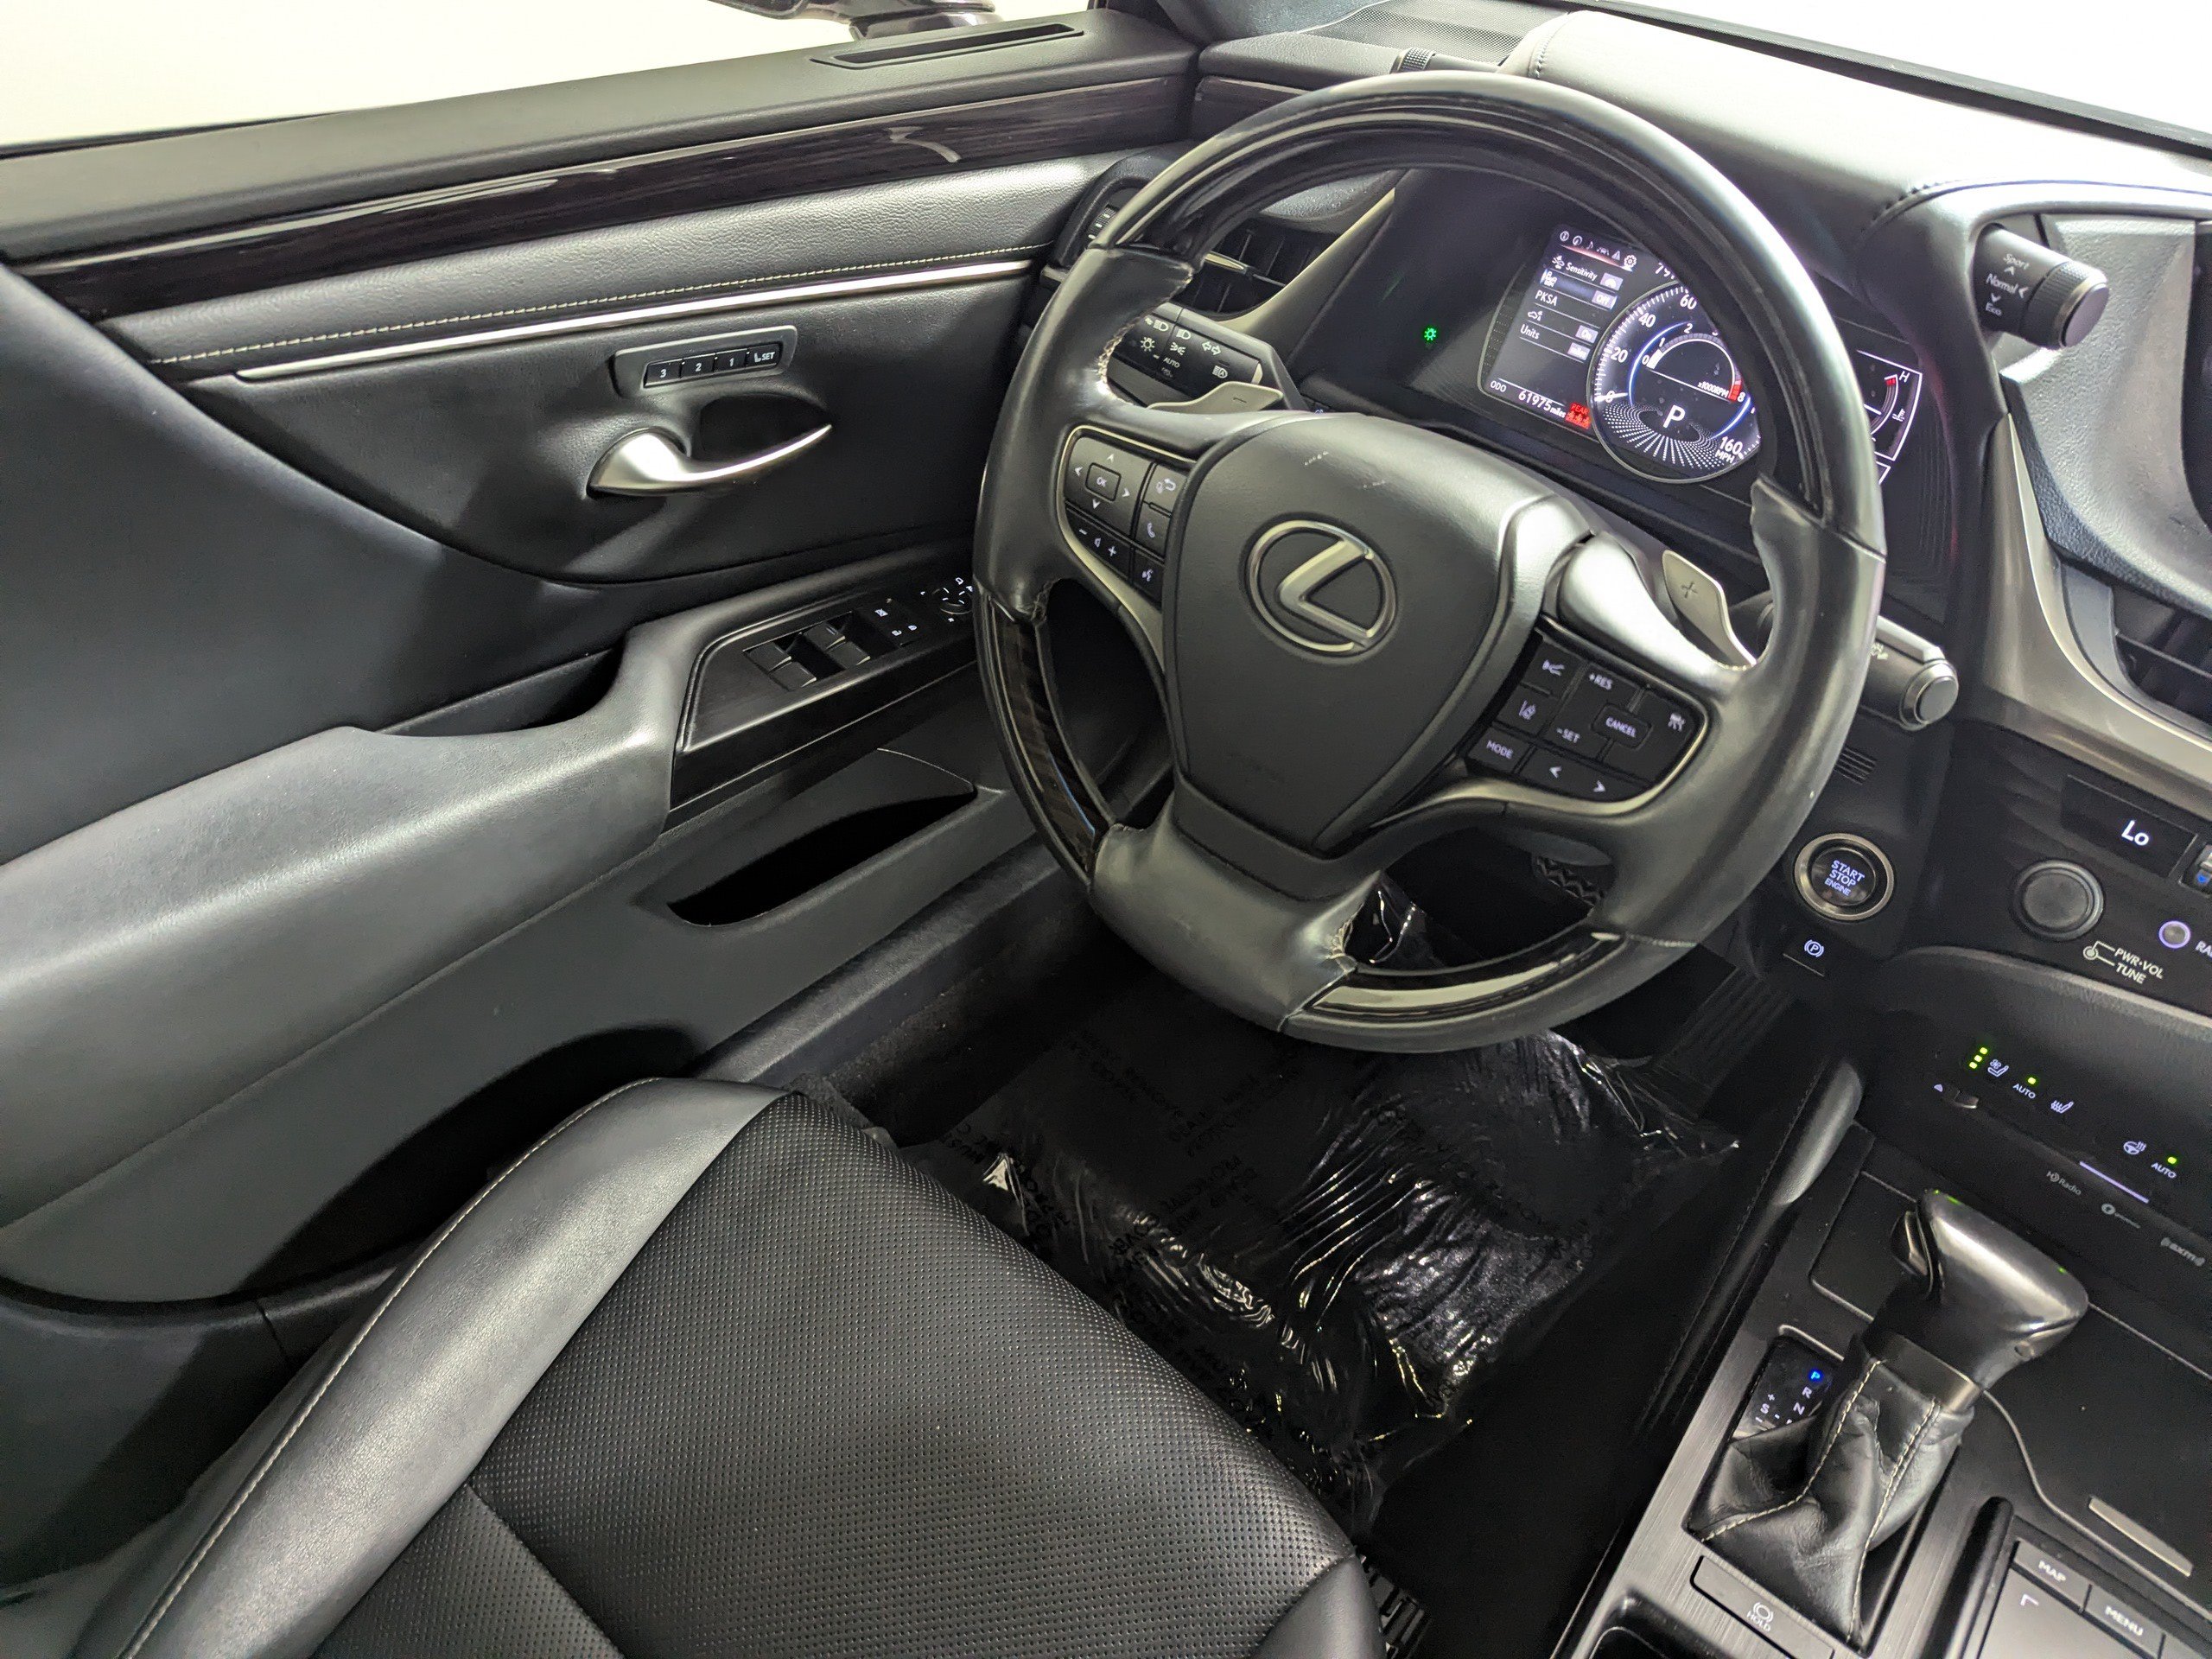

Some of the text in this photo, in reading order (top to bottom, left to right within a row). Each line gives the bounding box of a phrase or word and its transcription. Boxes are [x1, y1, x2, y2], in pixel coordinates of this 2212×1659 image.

[2003, 253, 2030, 270] Sport
[1565, 262, 1599, 282] Sensitivity
[1986, 273, 2019, 295] Normal
[1535, 289, 1558, 306] PKSA
[1679, 294, 1698, 310] 60
[1985, 302, 2002, 317] Eco
[1638, 314, 1657, 328] 40
[1684, 322, 1694, 334] 2
[1520, 323, 1541, 340] Units
[1658, 337, 1666, 347] 1
[1162, 357, 1181, 368] AUTO
[1610, 346, 1629, 363] 20
[1642, 356, 1649, 365] 0
[659, 351, 776, 378] 3 2 1 SET
[1898, 370, 1910, 383] H
[1490, 380, 1507, 393] ODO
[1518, 390, 1567, 418] 61975 miles
[1737, 391, 1745, 403] 8
[1662, 404, 1686, 429] P
[1719, 435, 1743, 455] 160
[1714, 448, 1735, 464] MPH
[1605, 716, 1637, 738] CANCEL
[1485, 739, 1514, 760] MODE
[2120, 820, 2150, 846] Lo
[1828, 869, 1857, 887] STOP
[1831, 860, 1866, 882] START
[1824, 877, 1852, 896] ENGINE
[2116, 961, 2147, 985] TUNE
[2012, 1083, 2037, 1100] AUTO
[2151, 1161, 2177, 1179] AUTO
[2058, 1178, 2082, 1196] Radio
[1810, 1370, 1821, 1380] P
[1802, 1386, 1813, 1399] R
[1760, 1403, 1770, 1414] S
[1793, 1402, 1805, 1415] N
[2037, 1560, 2067, 1583] MAP
[1746, 1610, 1771, 1632] HOLD
[2104, 1605, 2145, 1637] MENU
